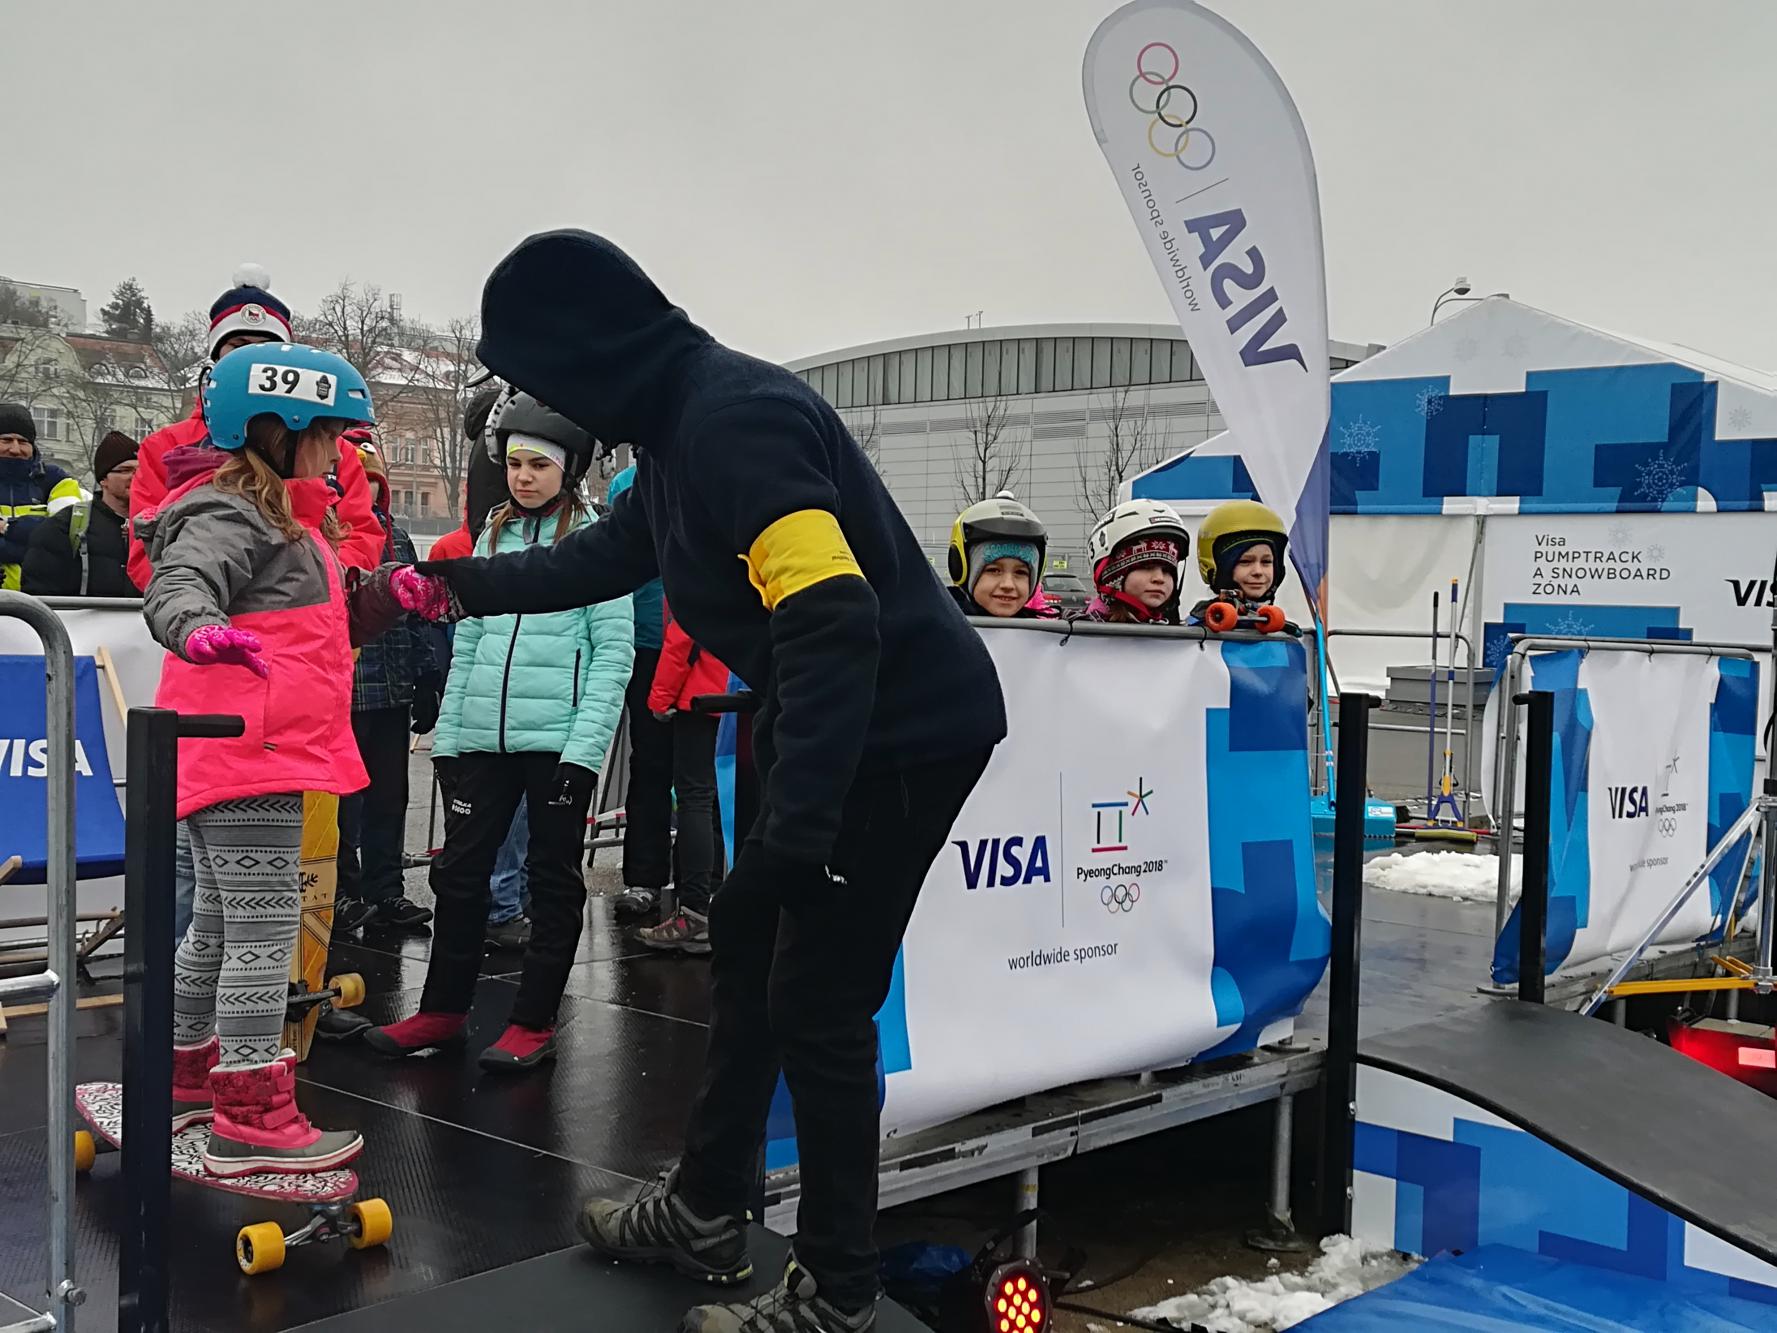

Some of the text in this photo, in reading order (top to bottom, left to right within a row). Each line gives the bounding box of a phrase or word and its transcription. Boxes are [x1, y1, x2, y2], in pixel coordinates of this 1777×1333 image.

[258, 366, 300, 394] 39
[1535, 534, 1566, 546] Visa
[1534, 550, 1642, 563] PUMPTRACK
[1532, 567, 1671, 580] A SNOWBOARD
[1532, 580, 1581, 595] ZÓNA
[1607, 785, 1649, 819] VISA
[951, 834, 1051, 890] VISA
[1076, 862, 1142, 882] PyeongChang
[1007, 942, 1119, 971] worldwide sponsor
